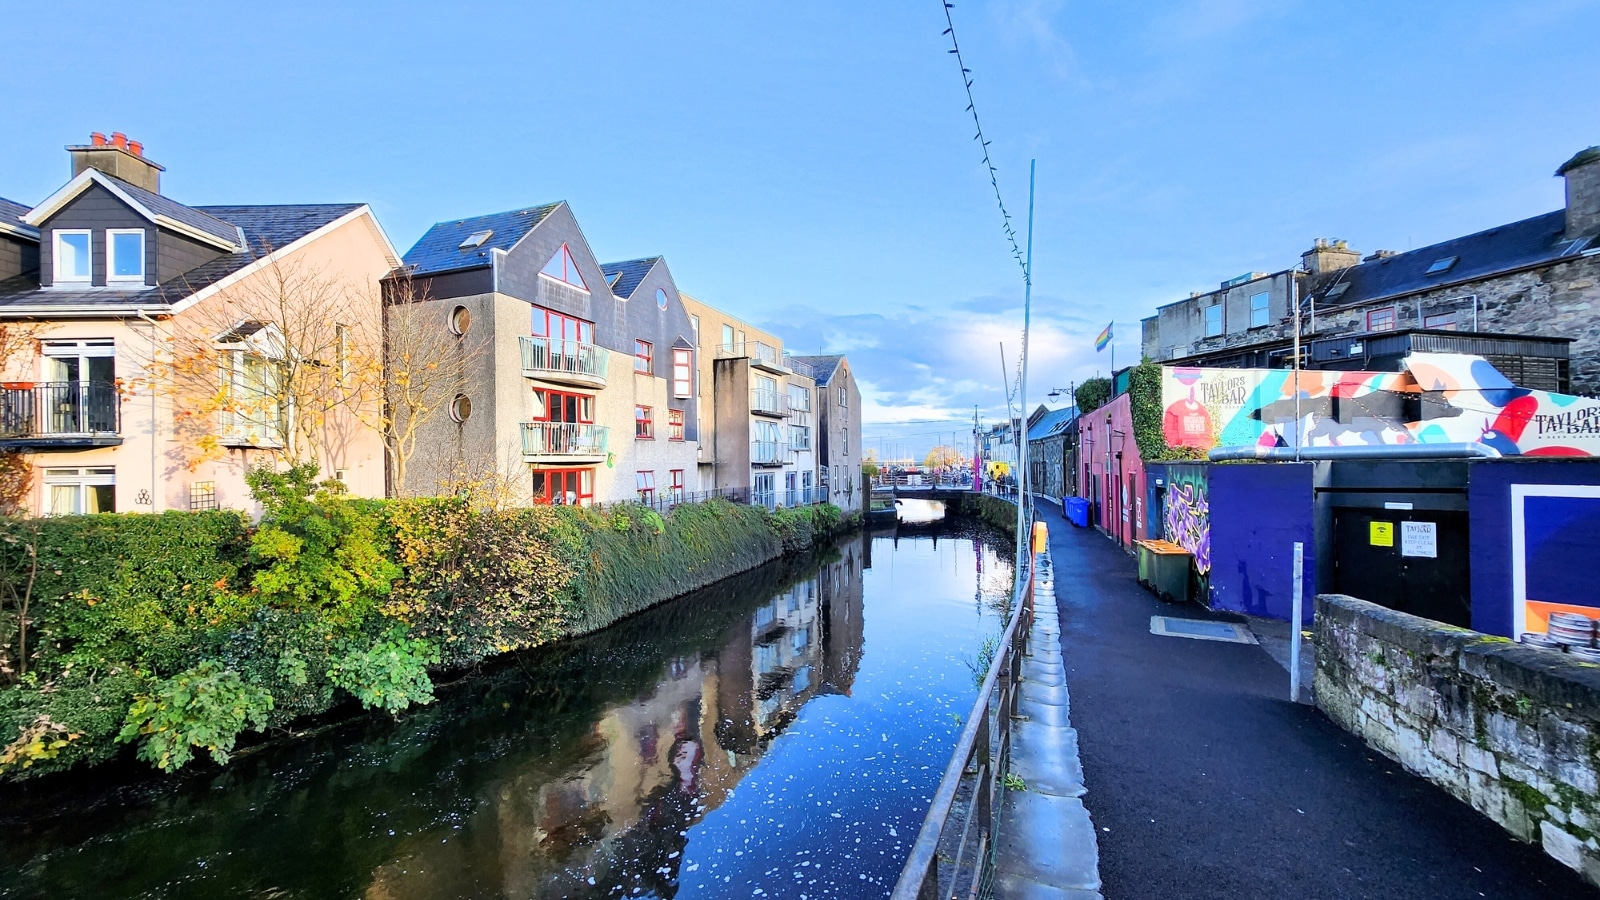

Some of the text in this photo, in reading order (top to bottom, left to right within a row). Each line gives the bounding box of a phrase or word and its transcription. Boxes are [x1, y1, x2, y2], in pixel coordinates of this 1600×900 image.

[1200, 376, 1246, 404] TAYLORS
[1221, 386, 1246, 405] BAR
[1535, 406, 1600, 434] TAYLOR
